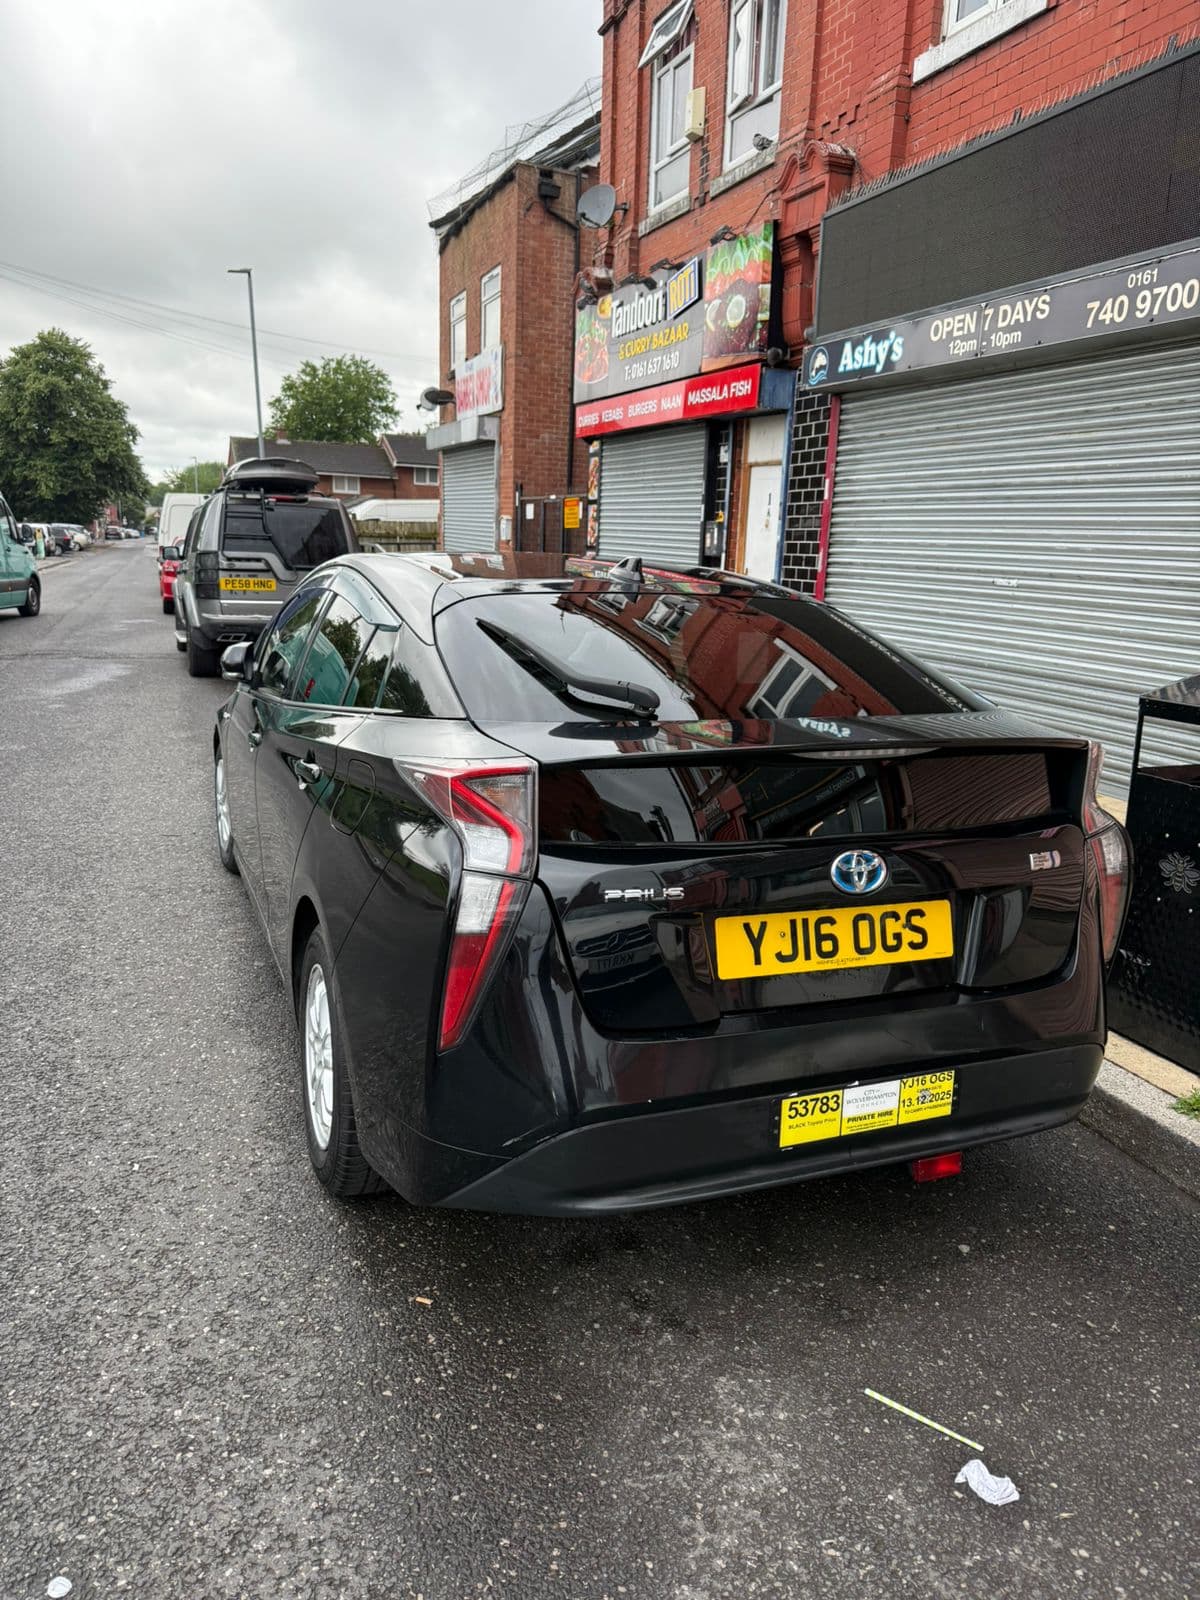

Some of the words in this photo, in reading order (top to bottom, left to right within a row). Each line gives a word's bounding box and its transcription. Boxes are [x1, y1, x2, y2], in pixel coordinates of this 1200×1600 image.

[1127, 268, 1158, 289] 0161
[612, 279, 664, 338] Tandoori
[1086, 294, 1129, 329] 740
[1135, 278, 1200, 318] 9700
[930, 310, 977, 342] OPEN
[984, 307, 994, 331] 7
[997, 294, 1050, 328] DAYS
[625, 334, 651, 358] CURRY
[651, 322, 689, 350] BAZAAR
[838, 330, 904, 373] Ashy's
[948, 339, 978, 356] 12pm
[990, 330, 1021, 349] 10pm
[647, 355, 661, 375] 637
[662, 350, 680, 371] 1610
[601, 407, 624, 423] KEBABS
[627, 400, 658, 418] BURGERS
[660, 393, 682, 411] NAAN
[687, 385, 729, 406] MASSALA
[729, 378, 751, 398] FISH
[225, 578, 250, 589] PE58
[604, 887, 685, 903] PRIUS
[742, 915, 839, 966] YJ16
[852, 908, 928, 955] OGS
[901, 1076, 926, 1089] YJ16
[929, 1071, 953, 1085] OGS
[788, 1094, 840, 1119] 53783
[847, 1113, 876, 1124] PRIVATE
[877, 1109, 894, 1119] HIRE
